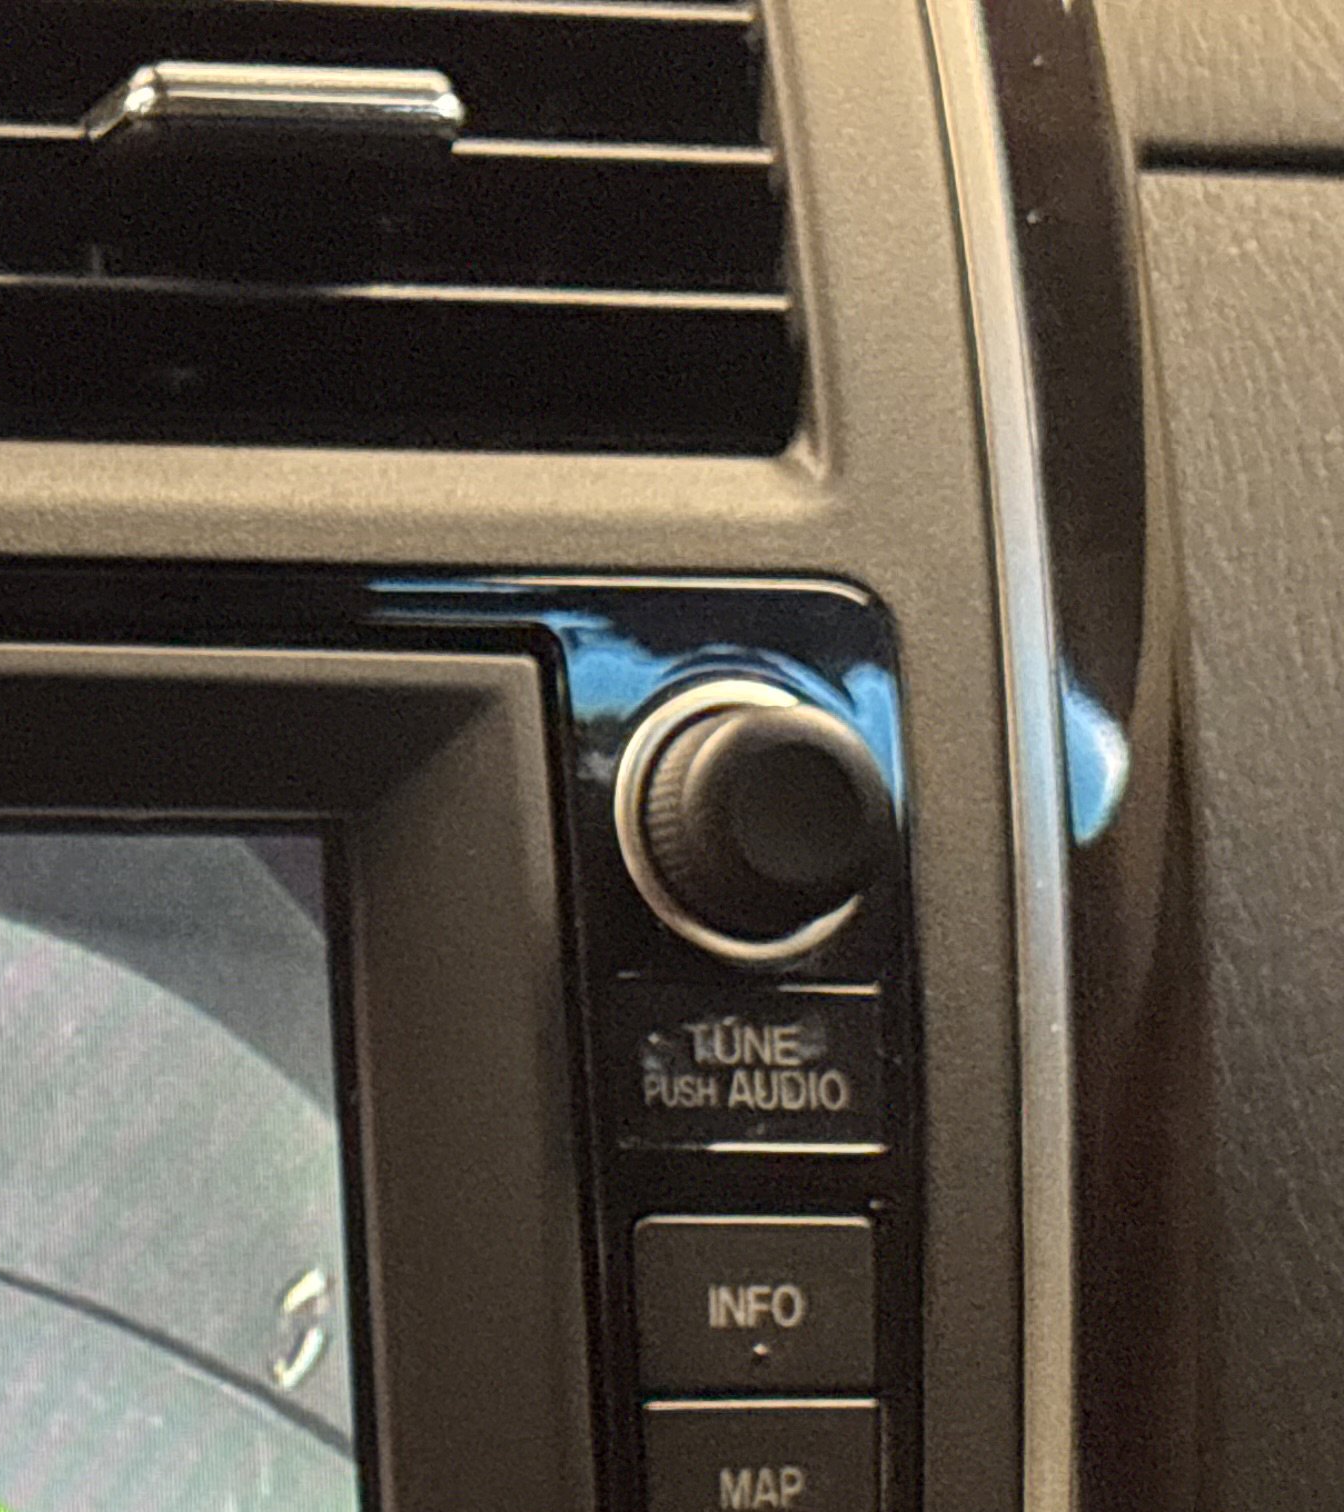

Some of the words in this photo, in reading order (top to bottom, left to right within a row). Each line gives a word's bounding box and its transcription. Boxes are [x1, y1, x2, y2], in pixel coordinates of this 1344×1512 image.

[688, 1023, 804, 1066] TUNE
[643, 1073, 717, 1107] PUSH
[727, 1068, 850, 1111] AUDIO
[708, 1284, 806, 1329] INFO
[720, 1467, 804, 1511] MAP
